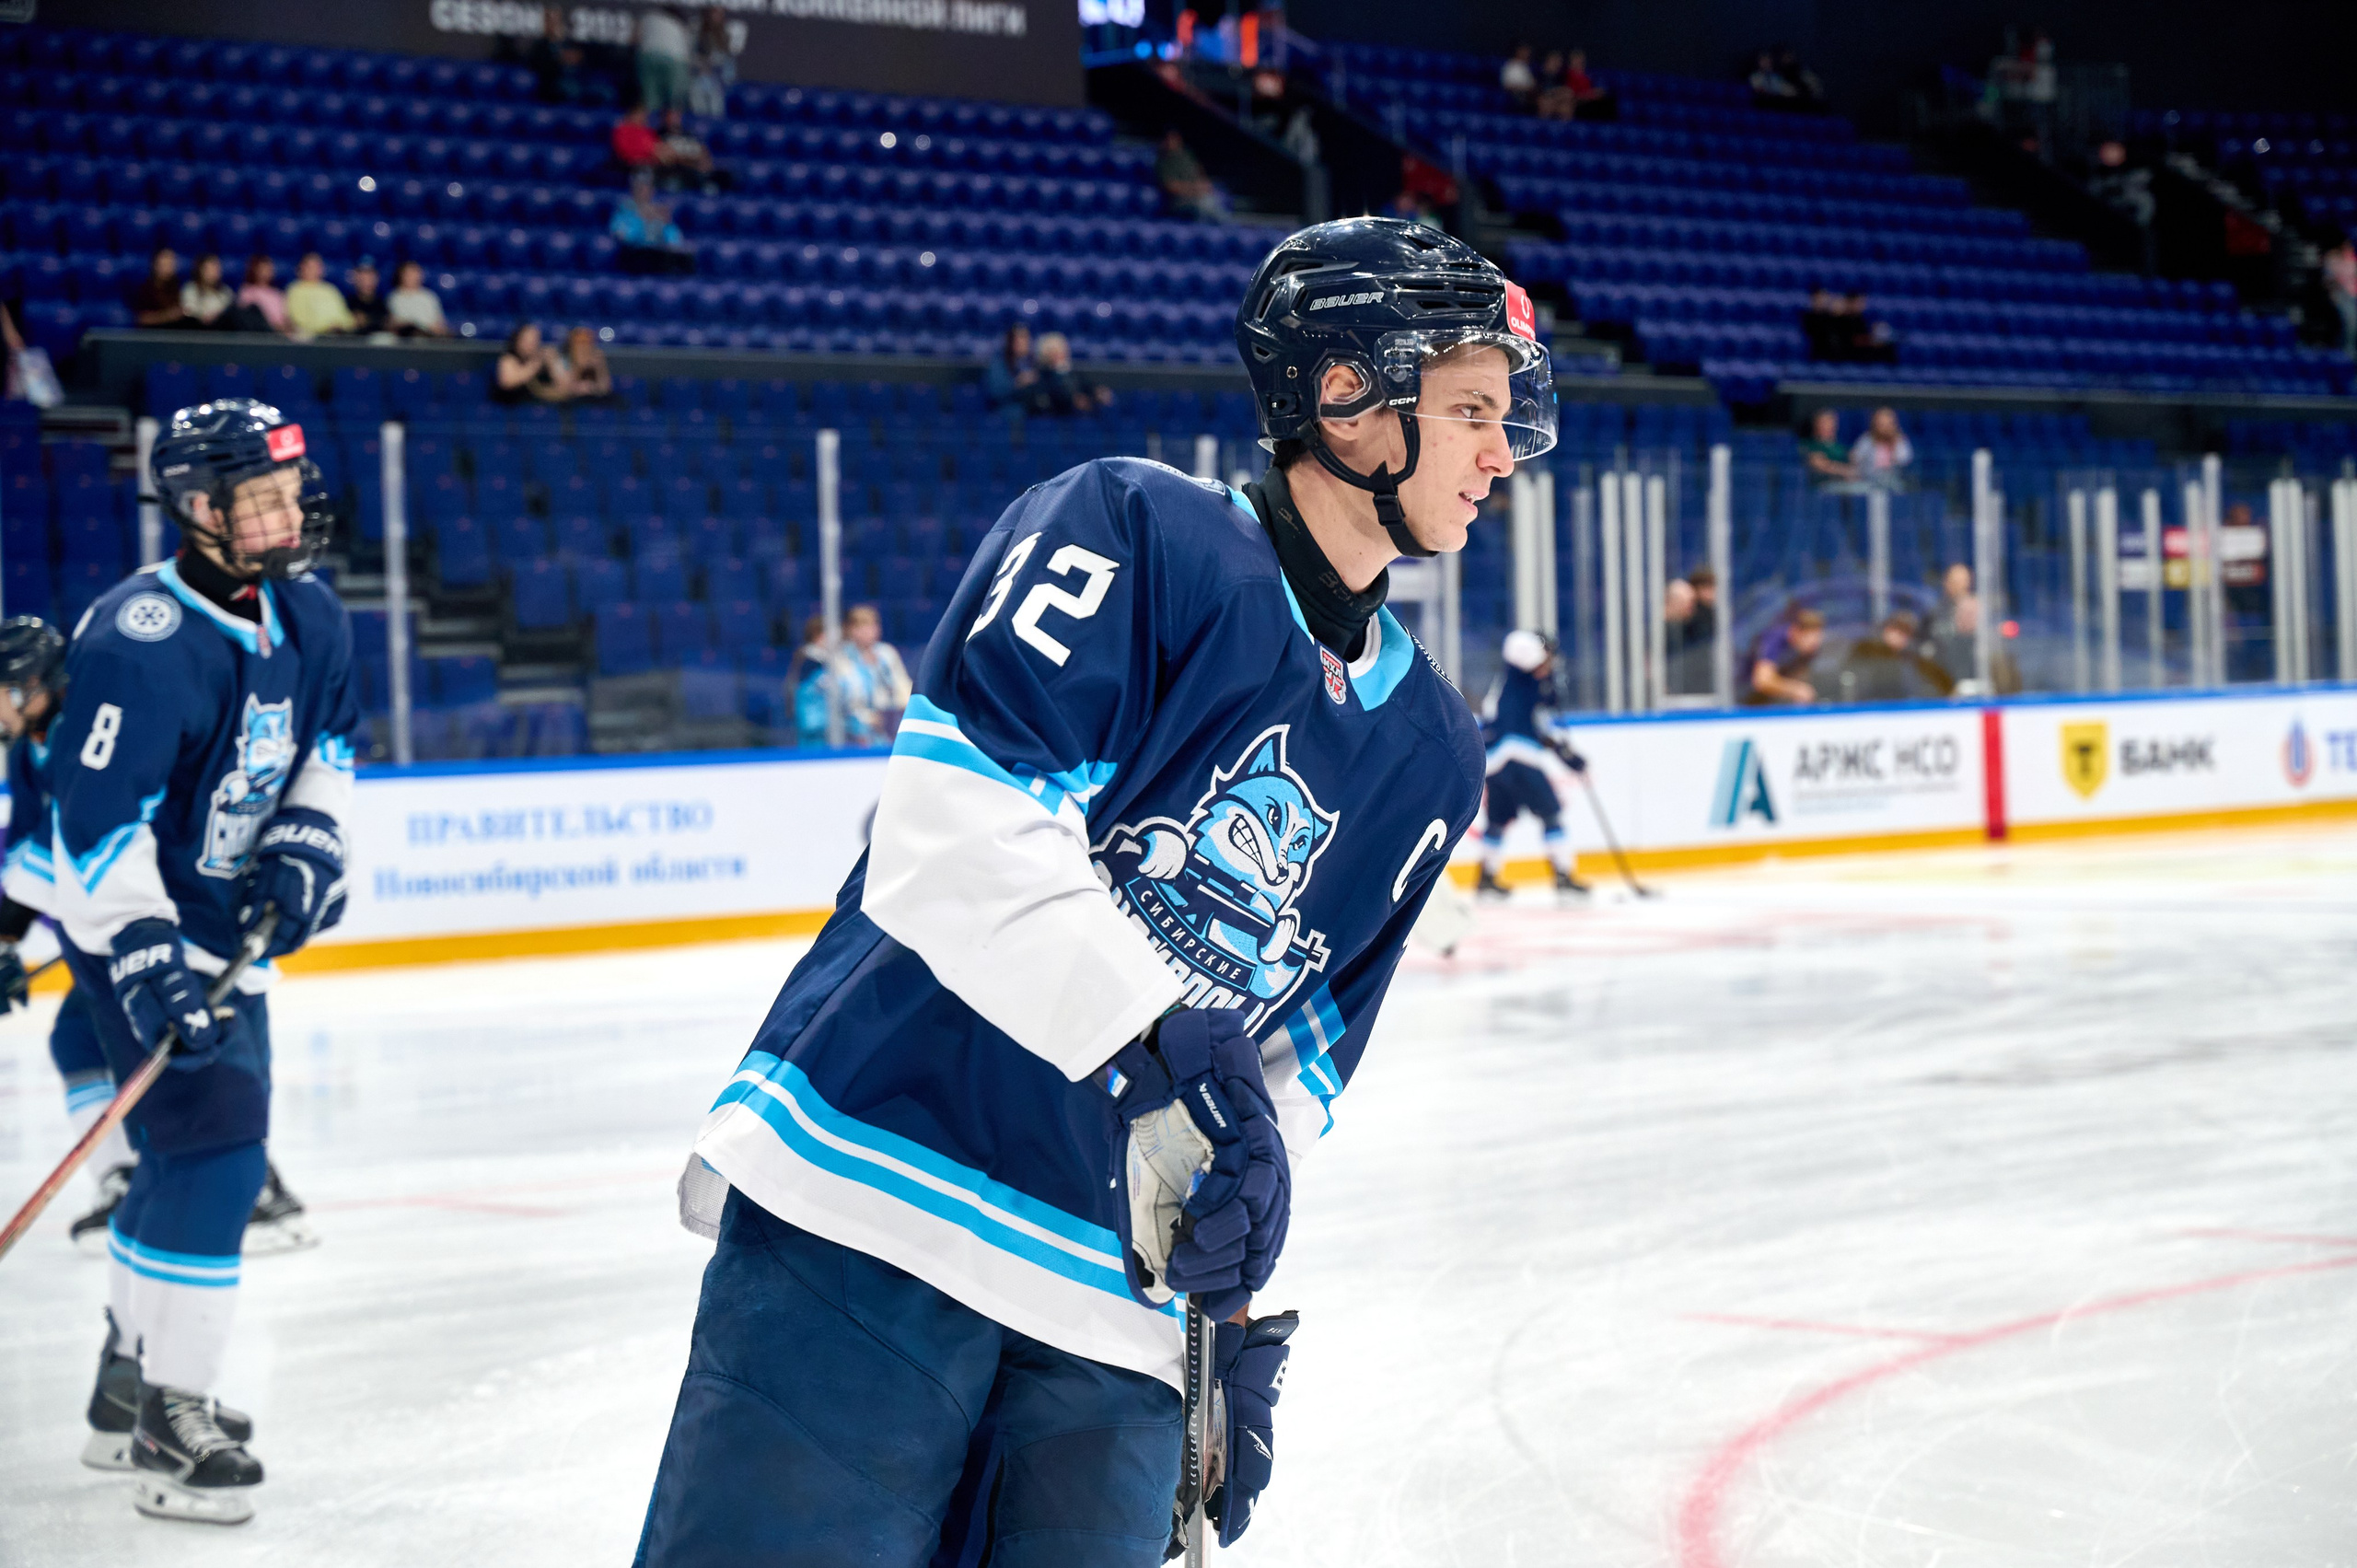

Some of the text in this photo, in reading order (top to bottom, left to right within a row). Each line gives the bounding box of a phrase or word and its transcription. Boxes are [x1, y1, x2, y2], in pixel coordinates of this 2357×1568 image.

[1309, 292, 1384, 310] BAUER
[1511, 316, 1536, 341] OLIMP
[1388, 396, 1417, 406] CCM
[966, 532, 1120, 667] 32
[80, 702, 123, 771] 8
[2119, 736, 2217, 777] БАНК
[261, 823, 343, 861] AUER
[407, 799, 714, 844] ПРАВИТЕЛЬСТВО
[374, 852, 747, 900] Новосибирской области
[1140, 889, 1242, 980] СИБИРСКИЕ
[110, 943, 173, 985] UER
[1202, 1092, 1227, 1129] BAUER
